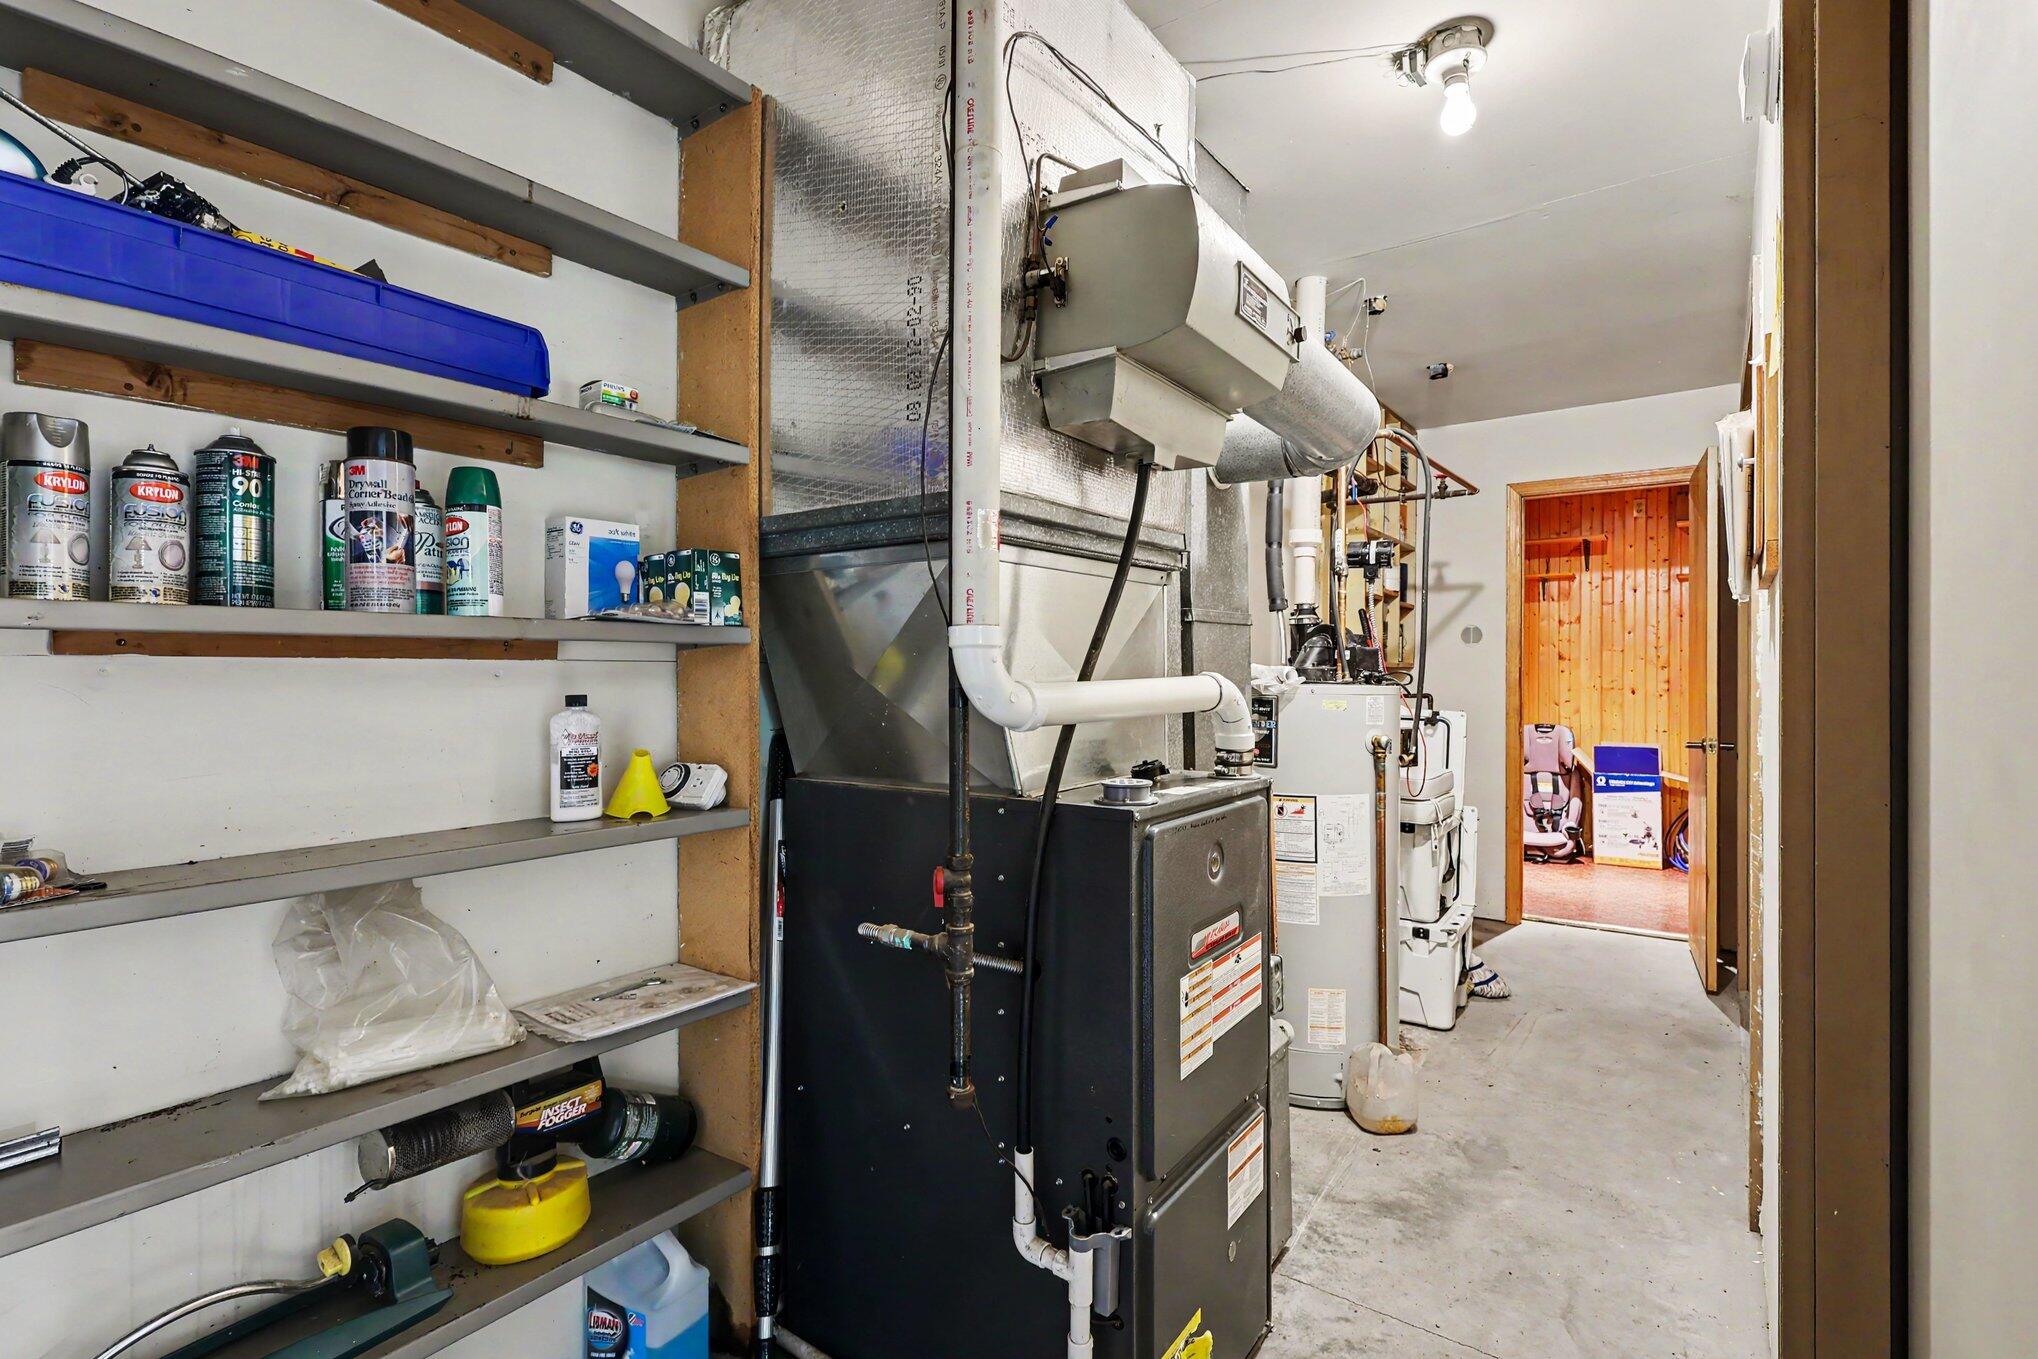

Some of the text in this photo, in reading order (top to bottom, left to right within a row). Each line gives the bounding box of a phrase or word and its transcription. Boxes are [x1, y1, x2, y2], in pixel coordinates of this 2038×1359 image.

[232, 454, 259, 469] 3M
[349, 465, 365, 476] 3M
[43, 474, 85, 492] KRYLON
[231, 475, 263, 498] 90
[349, 480, 387, 491] Drywall
[137, 485, 179, 500] KRYLON
[348, 489, 382, 499] Corner
[541, 1095, 582, 1119] INSECT
[536, 1102, 588, 1131] FOGGER
